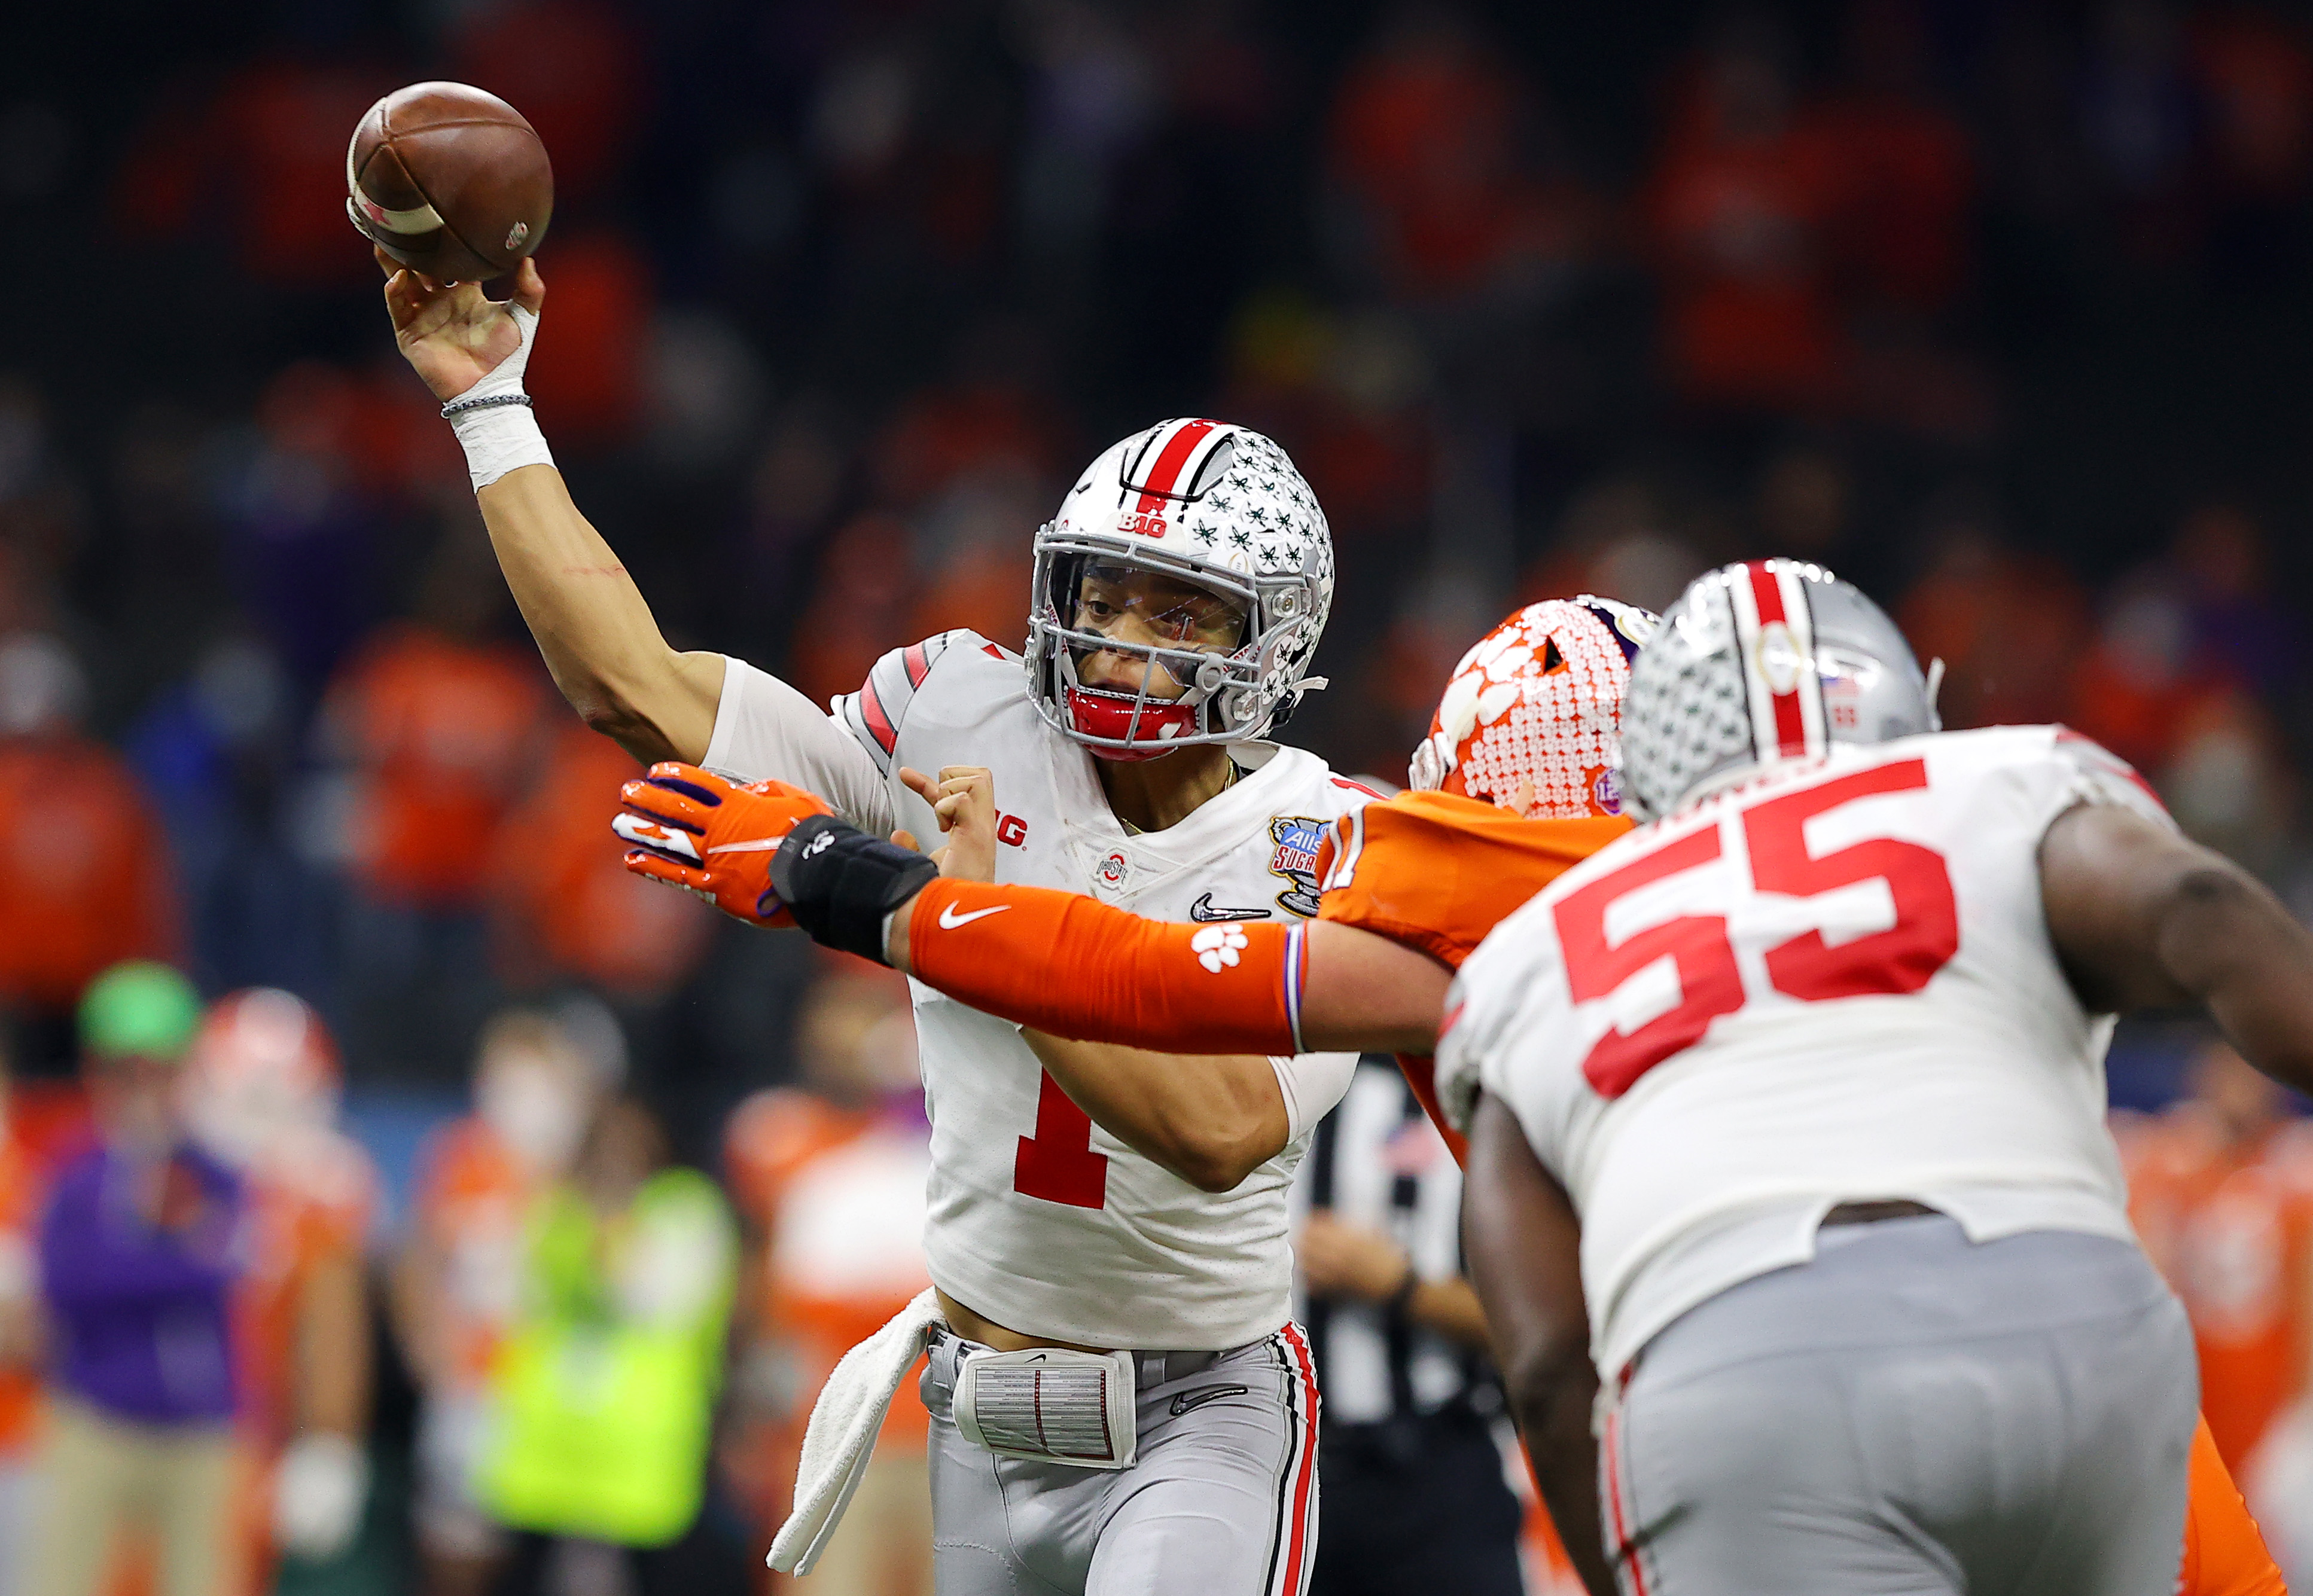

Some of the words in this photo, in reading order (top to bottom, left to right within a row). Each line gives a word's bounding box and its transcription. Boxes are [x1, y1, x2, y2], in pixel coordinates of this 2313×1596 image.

[1110, 861, 1127, 885] STATE
[1273, 846, 1317, 873] SUGA
[1553, 758, 1959, 1100] 55
[1014, 1065, 1108, 1210] 1
